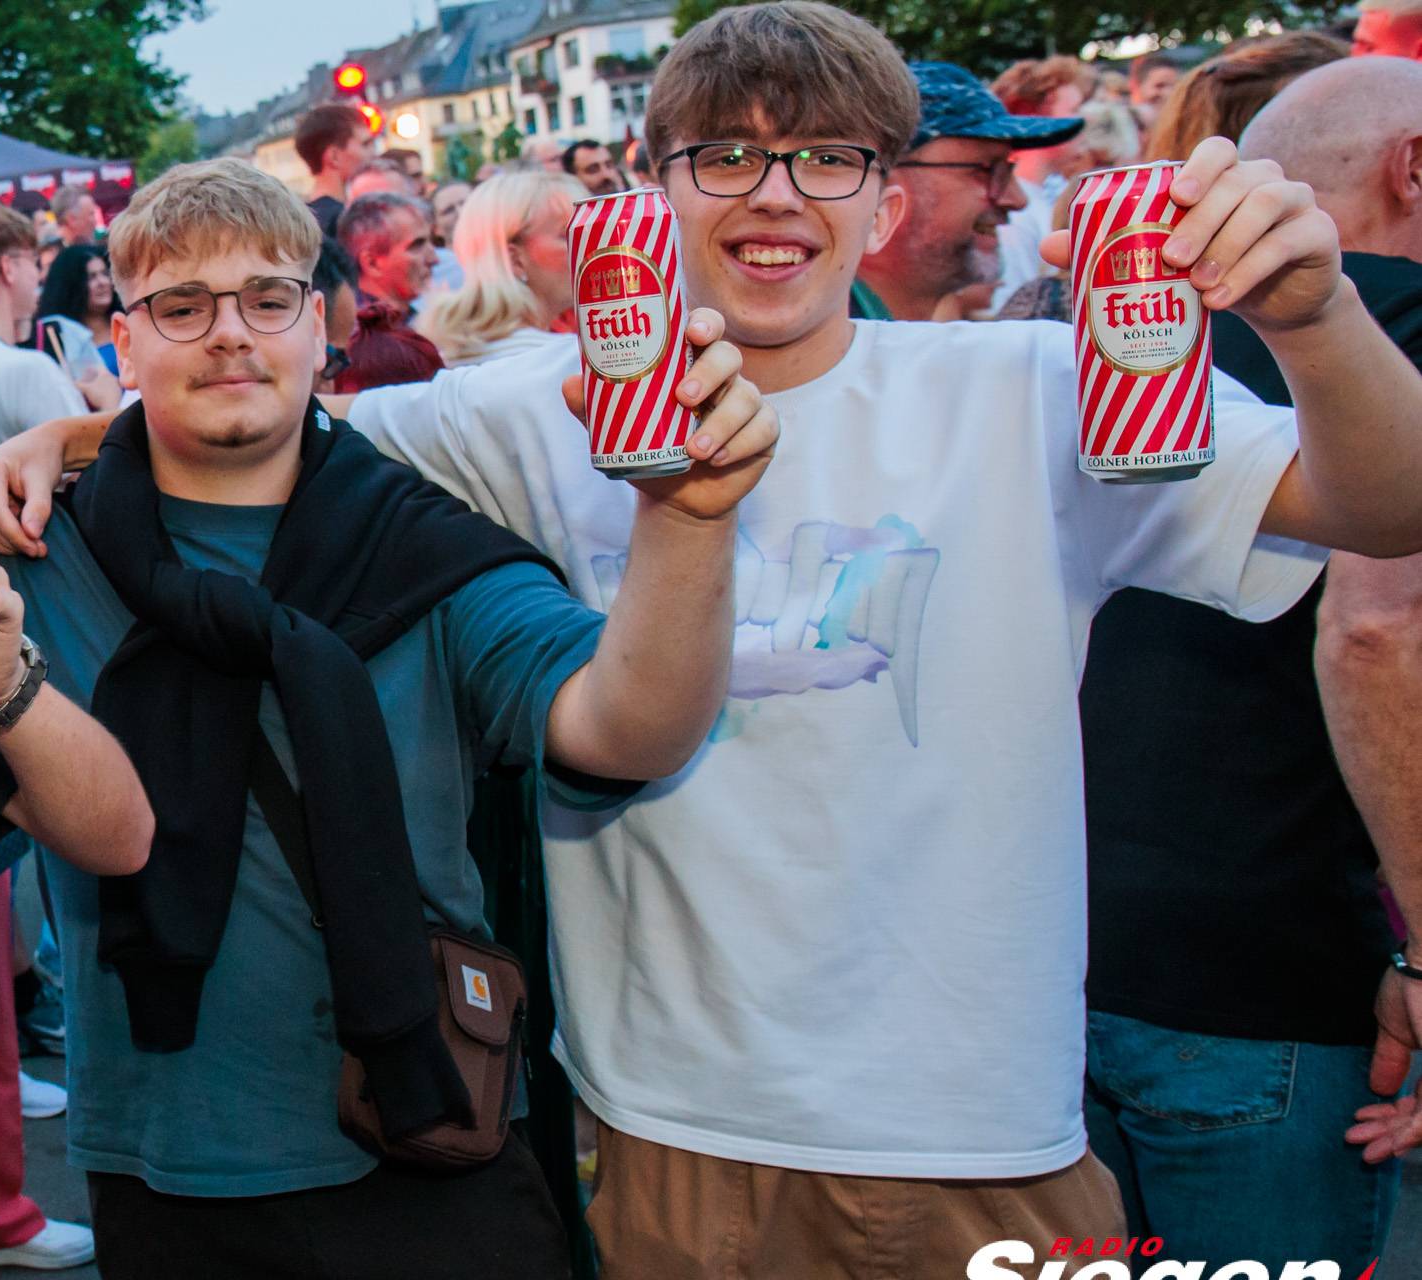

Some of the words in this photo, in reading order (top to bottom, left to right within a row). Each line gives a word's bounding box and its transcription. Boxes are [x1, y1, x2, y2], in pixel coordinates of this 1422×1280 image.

[1103, 286, 1186, 329] früh
[586, 303, 651, 341] früh
[1123, 327, 1173, 340] KÖLSCH
[601, 339, 640, 351] KÖLSCH
[607, 453, 625, 464] FÜR
[1087, 456, 1129, 467] CÖLNER
[1134, 451, 1196, 465] HOFBRÄU
